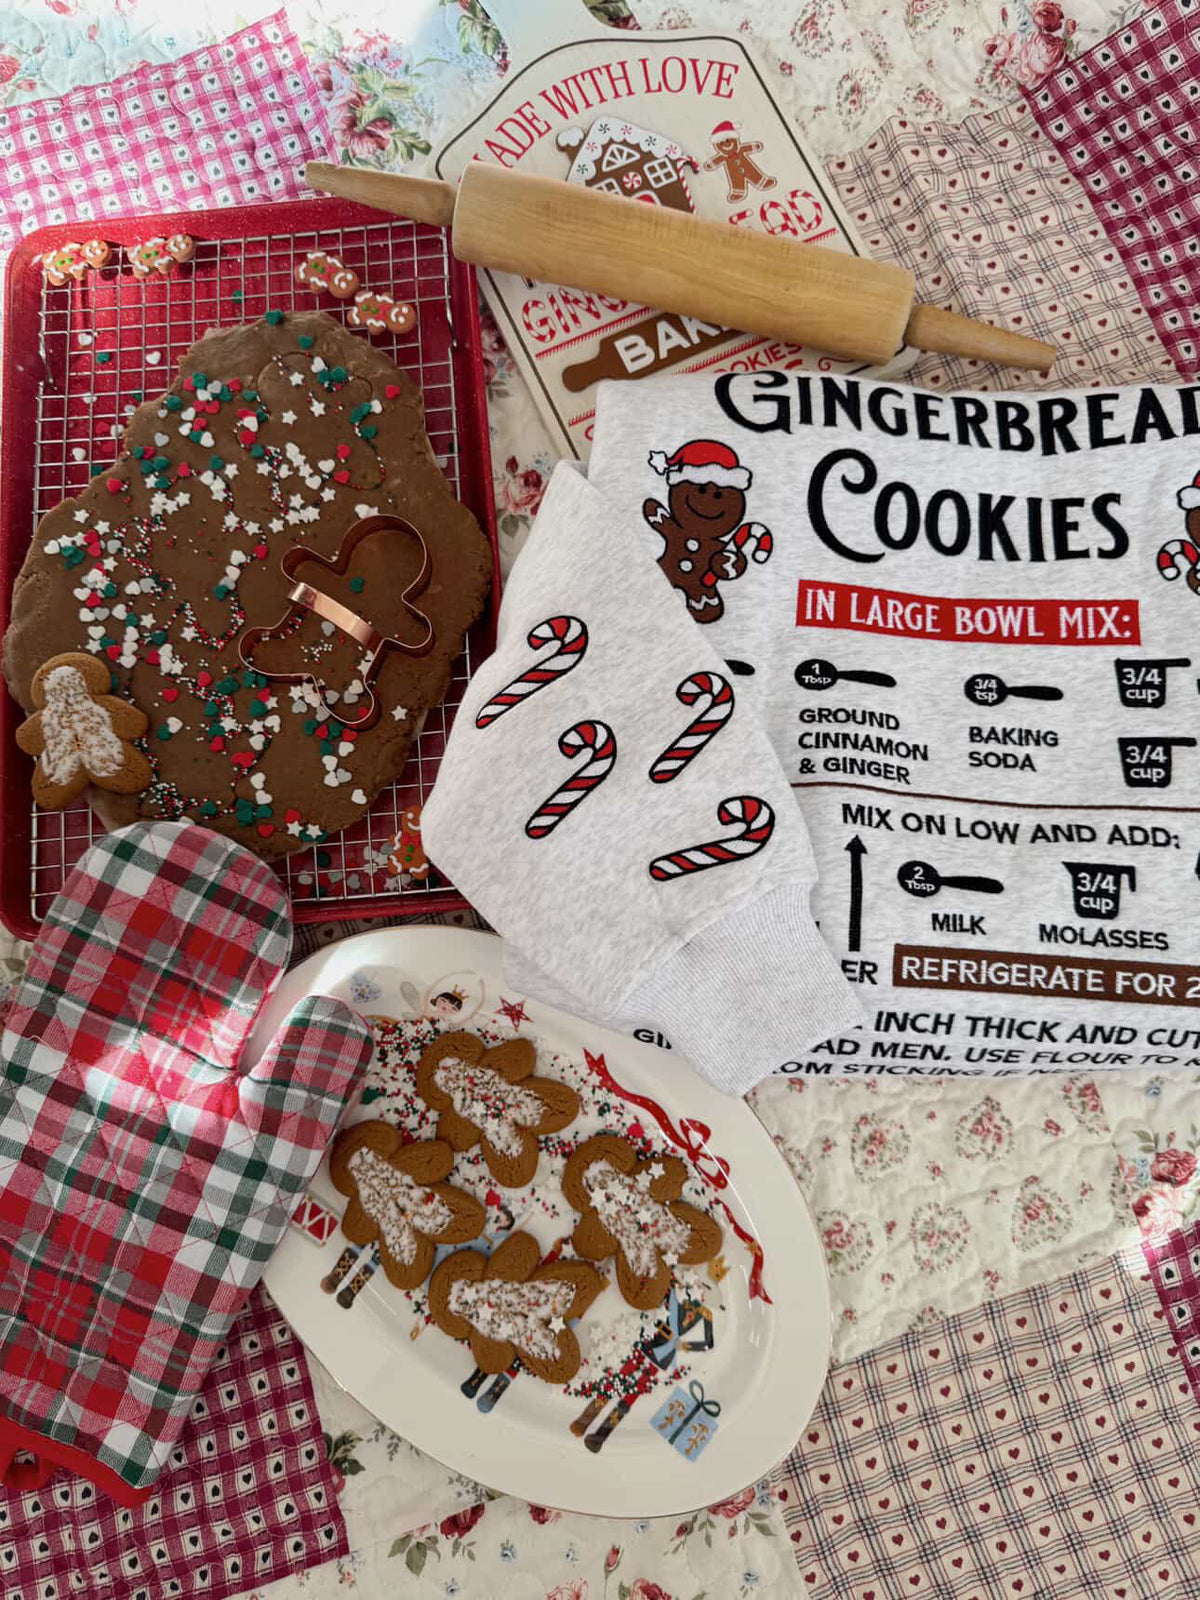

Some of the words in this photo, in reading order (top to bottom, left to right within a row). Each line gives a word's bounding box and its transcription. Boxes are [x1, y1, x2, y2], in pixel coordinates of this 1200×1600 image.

[472, 101, 552, 168] ADE
[538, 60, 635, 120] WITH
[641, 56, 739, 99] LOVE
[614, 311, 730, 374] BAK
[714, 341, 804, 374] OKIES
[807, 448, 1129, 563] COOKIES
[805, 588, 835, 621] IN
[849, 592, 941, 633] LARGE
[954, 605, 1044, 637] BOWL
[1059, 606, 1132, 639] MIX:
[800, 674, 832, 685] Tbsp
[811, 662, 820, 675] 1
[1121, 667, 1162, 686] 3/4
[974, 678, 997, 690] 3/4
[975, 690, 998, 702] tsp
[1125, 688, 1160, 703] cup
[799, 708, 900, 730] GROUND
[798, 732, 928, 761] CINNAMON
[968, 726, 1059, 747] BAKING
[968, 751, 1037, 773] SODA
[1125, 745, 1168, 764] 3/4
[799, 757, 816, 774] &
[823, 757, 911, 785] GINGER
[1130, 767, 1165, 782] cup
[842, 803, 894, 831] MIX
[901, 812, 946, 835] ON
[955, 816, 1020, 845] LOW
[1030, 823, 1097, 843] AND
[913, 866, 925, 880] 2
[1076, 872, 1117, 893] 3/4
[905, 879, 935, 892] Tbsp
[1080, 896, 1114, 914] cup
[931, 913, 987, 936] MILK
[1038, 923, 1169, 951] MOLASSES
[902, 956, 1104, 992] REFRIGERATE
[1115, 971, 1176, 998] FOR
[874, 1010, 956, 1035] INCH
[965, 1015, 1061, 1043] THICK
[1065, 1023, 1138, 1045] AND
[633, 1028, 672, 1050] GI
[871, 1041, 952, 1061] MEN.
[965, 1047, 1026, 1064] USE
[1031, 1051, 1134, 1065] FLOUR
[1139, 1054, 1180, 1065] TO
[772, 1061, 833, 1075] OM
[843, 1063, 984, 1076] STICKING
